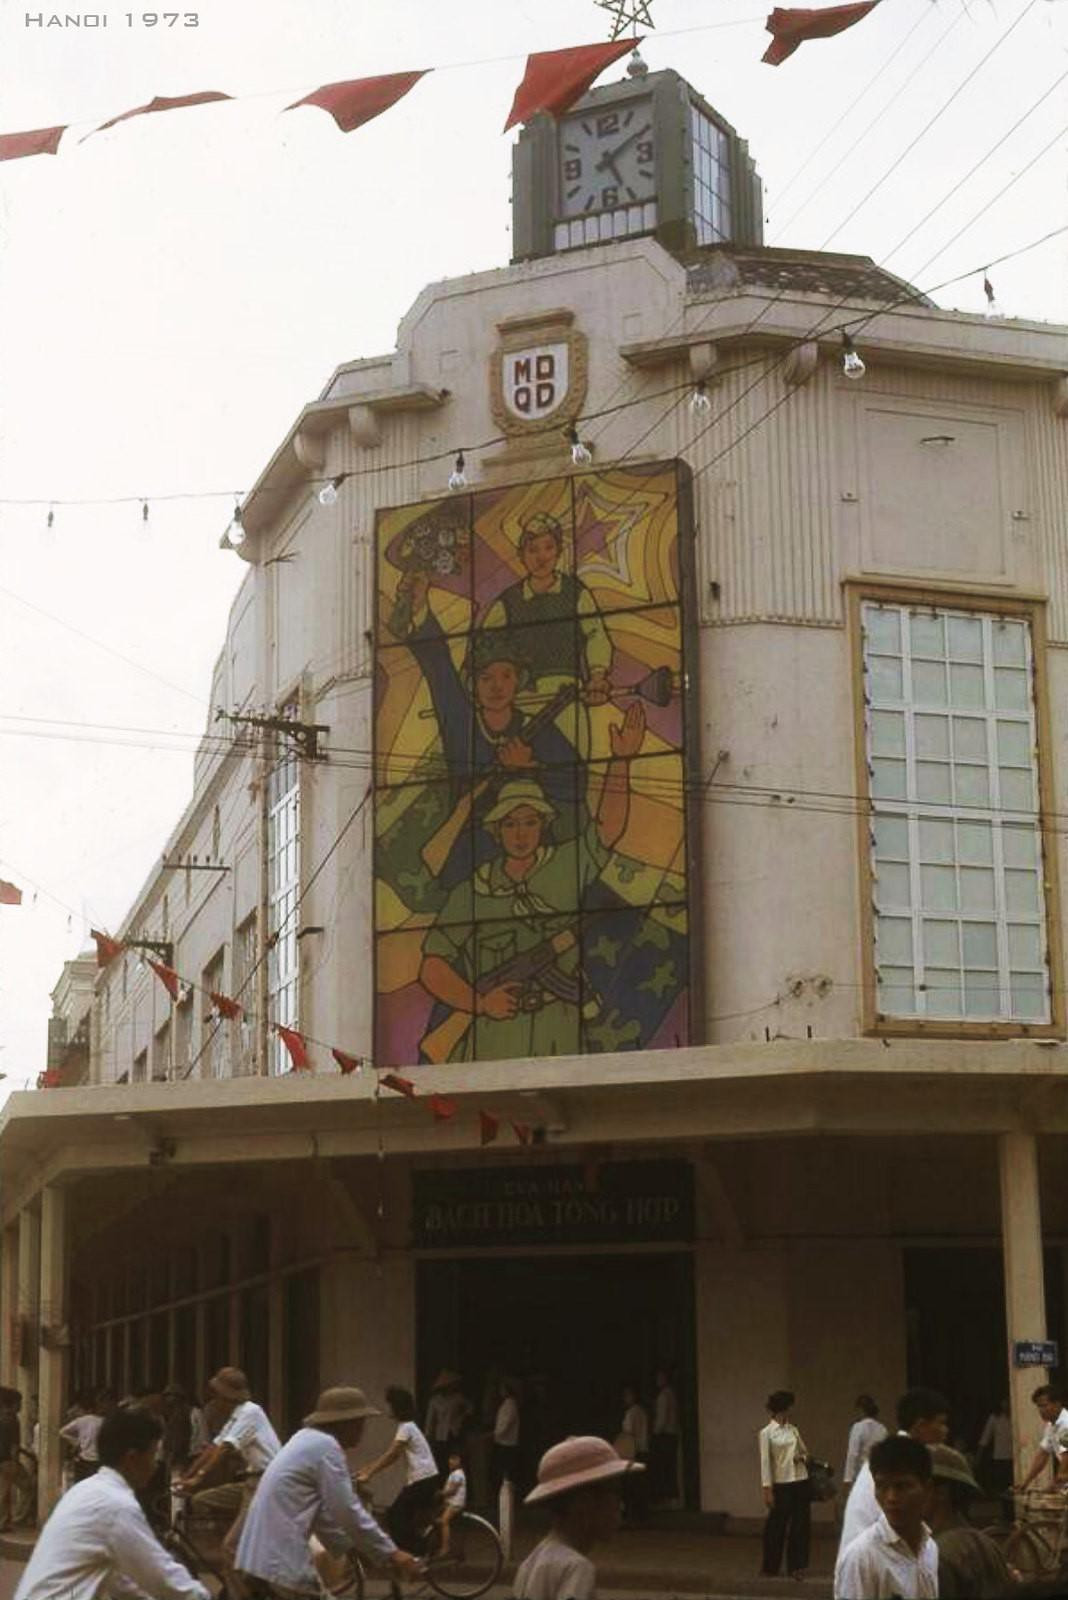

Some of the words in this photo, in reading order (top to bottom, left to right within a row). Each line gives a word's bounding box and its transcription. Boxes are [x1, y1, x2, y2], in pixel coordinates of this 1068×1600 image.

[596, 113, 620, 138] 12
[637, 142, 653, 164] 3
[565, 159, 582, 181] 9
[601, 186, 618, 207] 6
[515, 354, 556, 387] MD
